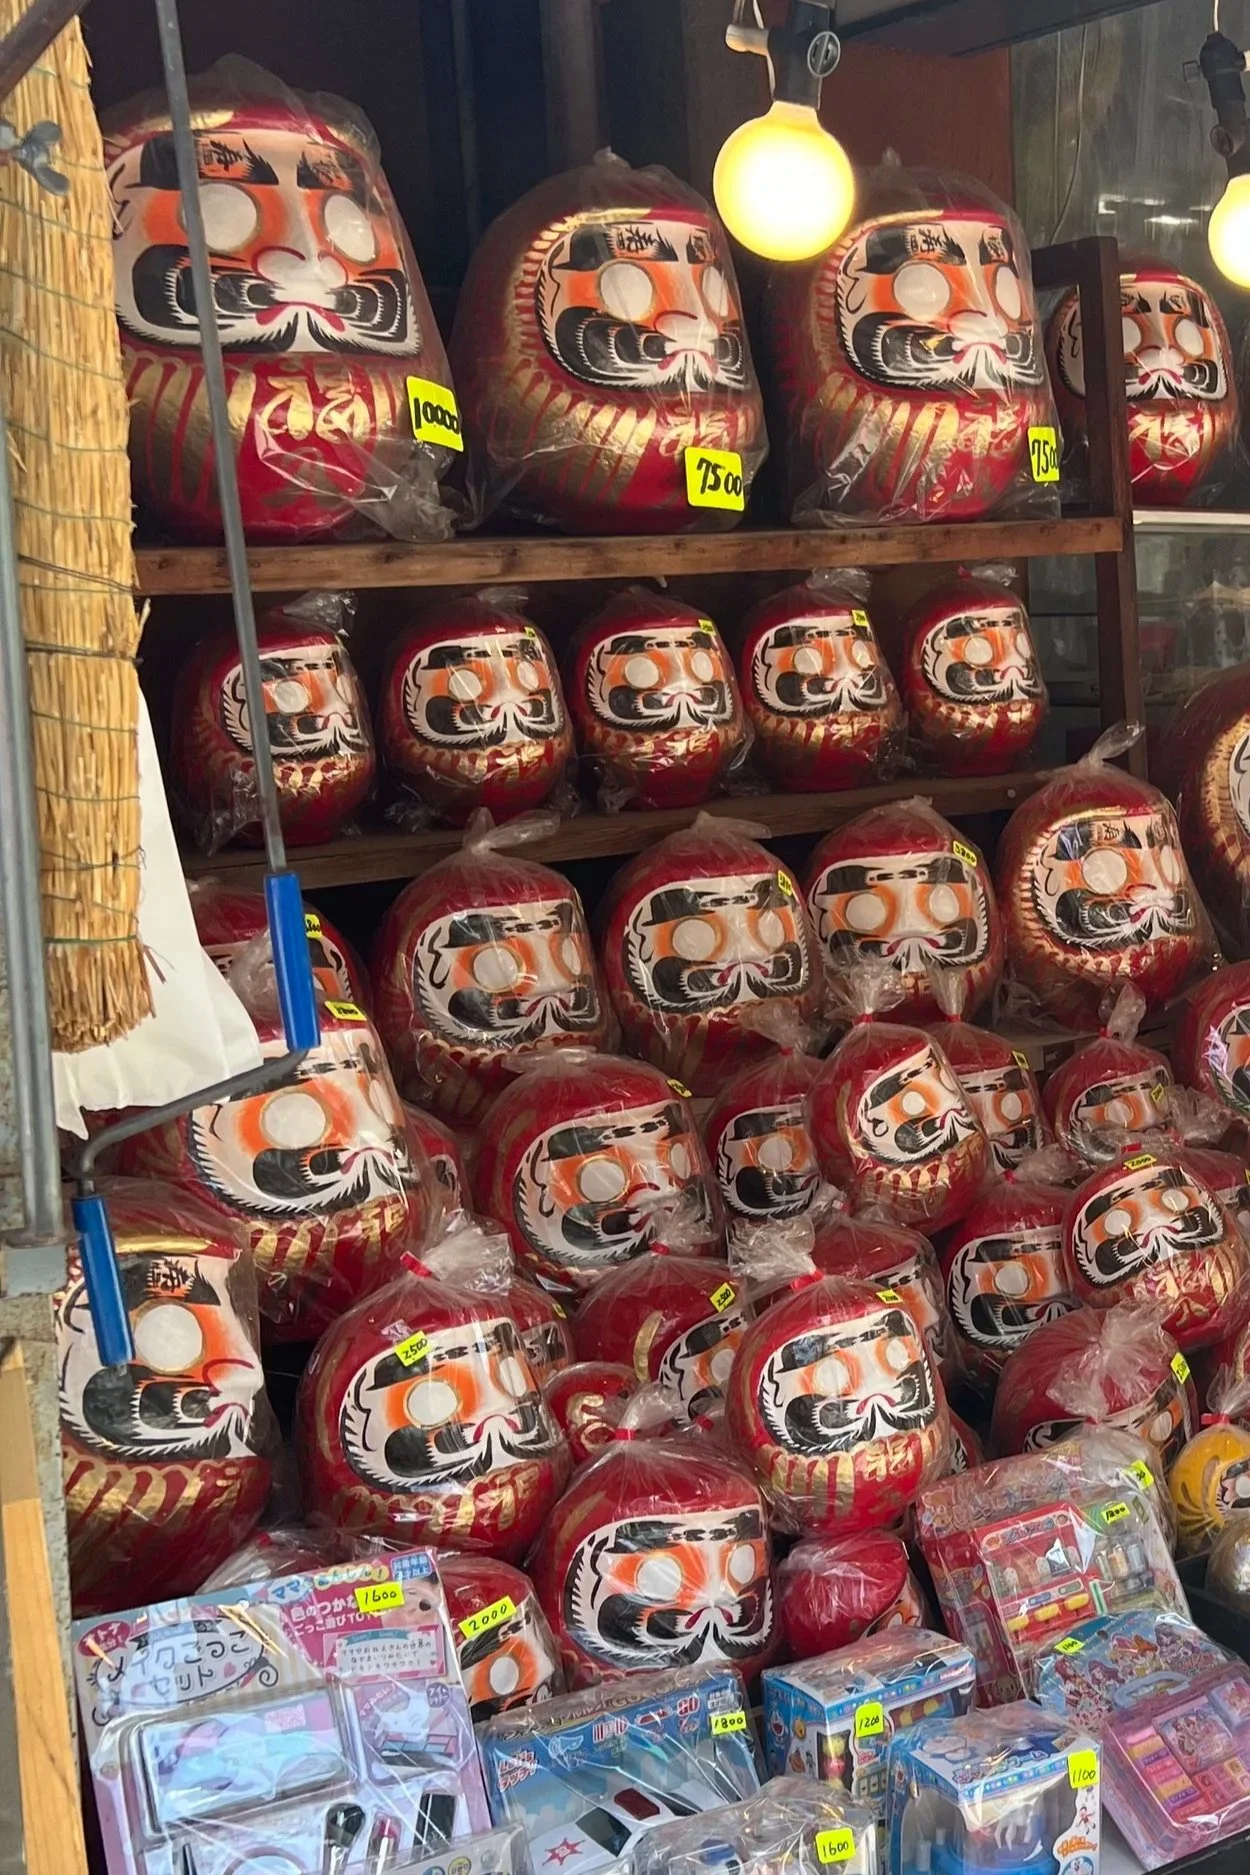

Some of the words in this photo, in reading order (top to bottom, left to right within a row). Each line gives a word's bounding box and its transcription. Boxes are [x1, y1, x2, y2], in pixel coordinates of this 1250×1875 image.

[414, 398, 460, 434] 10000
[696, 457, 743, 497] 7500
[402, 1338, 428, 1360] 2500
[365, 1589, 397, 1605] 1600
[468, 1604, 508, 1631] 2000
[714, 1717, 744, 1729] 1800
[859, 1715, 880, 1731] 1200
[1072, 1769, 1096, 1782] 1100
[823, 1840, 849, 1858] 1600
